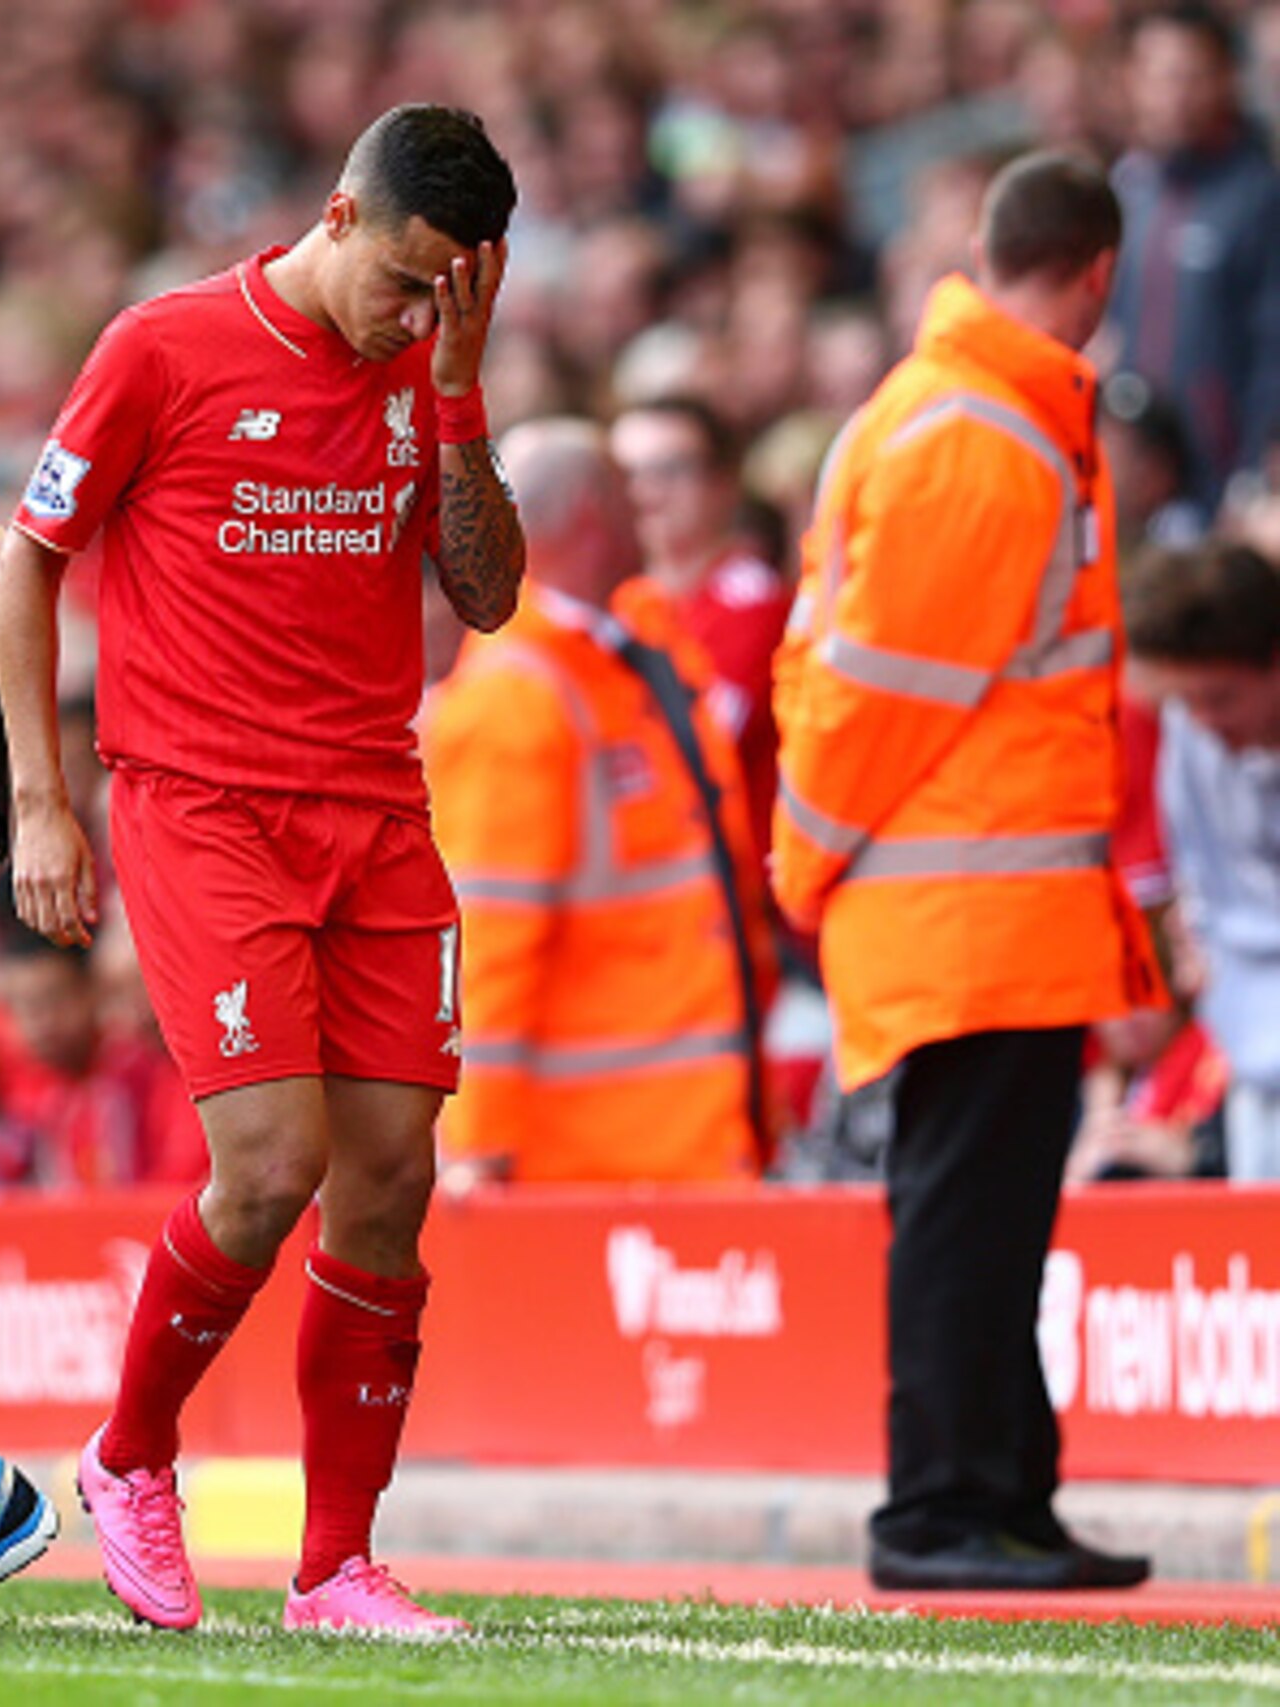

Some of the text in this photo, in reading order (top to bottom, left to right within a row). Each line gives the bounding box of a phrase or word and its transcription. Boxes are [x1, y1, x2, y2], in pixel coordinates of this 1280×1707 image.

[231, 480, 385, 515] Standard
[218, 519, 383, 554] Chartered
[1084, 1284, 1172, 1414] new
[1172, 1251, 1280, 1419] bala
